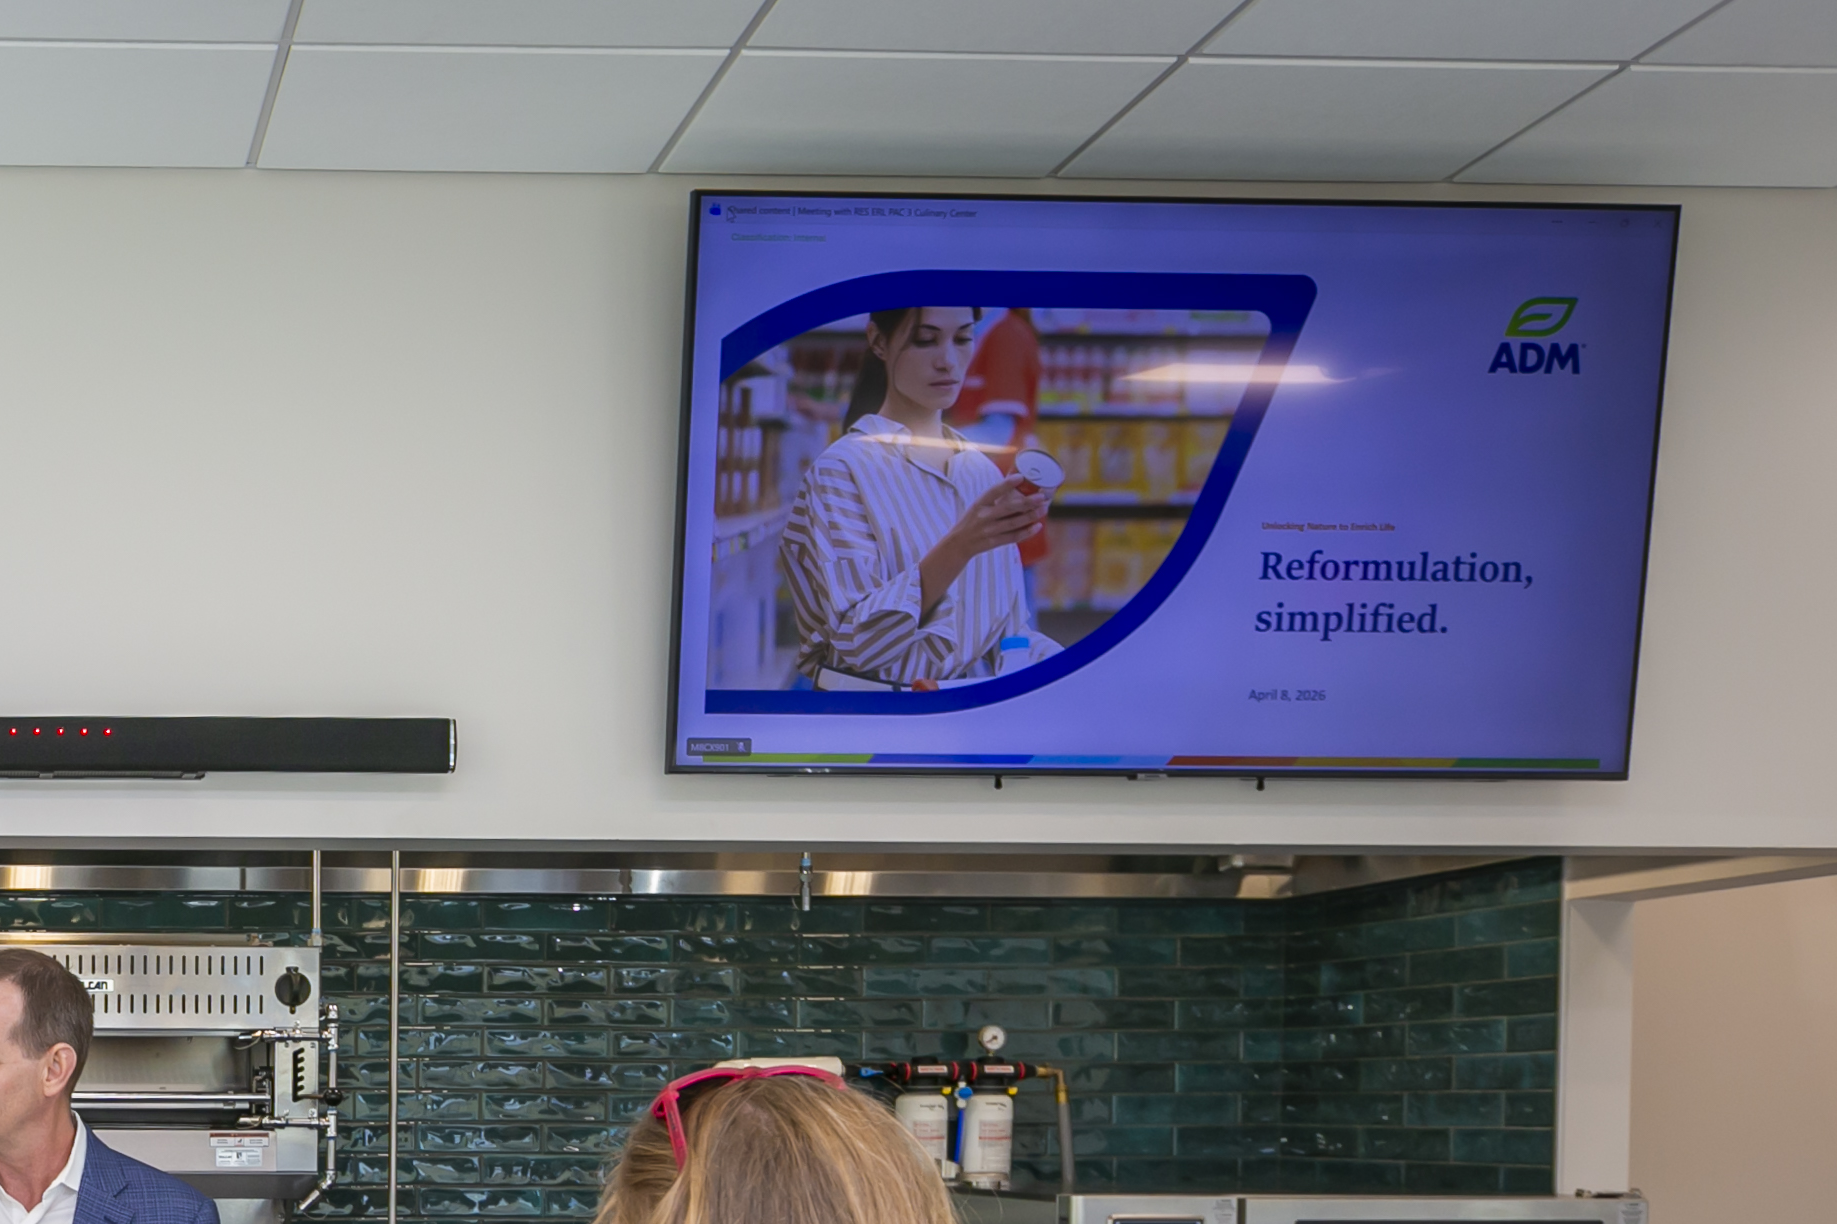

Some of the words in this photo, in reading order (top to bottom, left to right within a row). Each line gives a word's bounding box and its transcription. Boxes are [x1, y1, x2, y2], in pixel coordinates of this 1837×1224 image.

[915, 208, 947, 219] Culinary
[949, 209, 977, 217] Center
[1487, 342, 1581, 375] ADM
[1262, 522, 1304, 532] Unlocking
[1259, 550, 1533, 589] Reformulation,
[1254, 602, 1448, 641] simplified.
[1248, 689, 1278, 702] April
[1280, 690, 1292, 702] 8,
[1295, 690, 1327, 701] 2026
